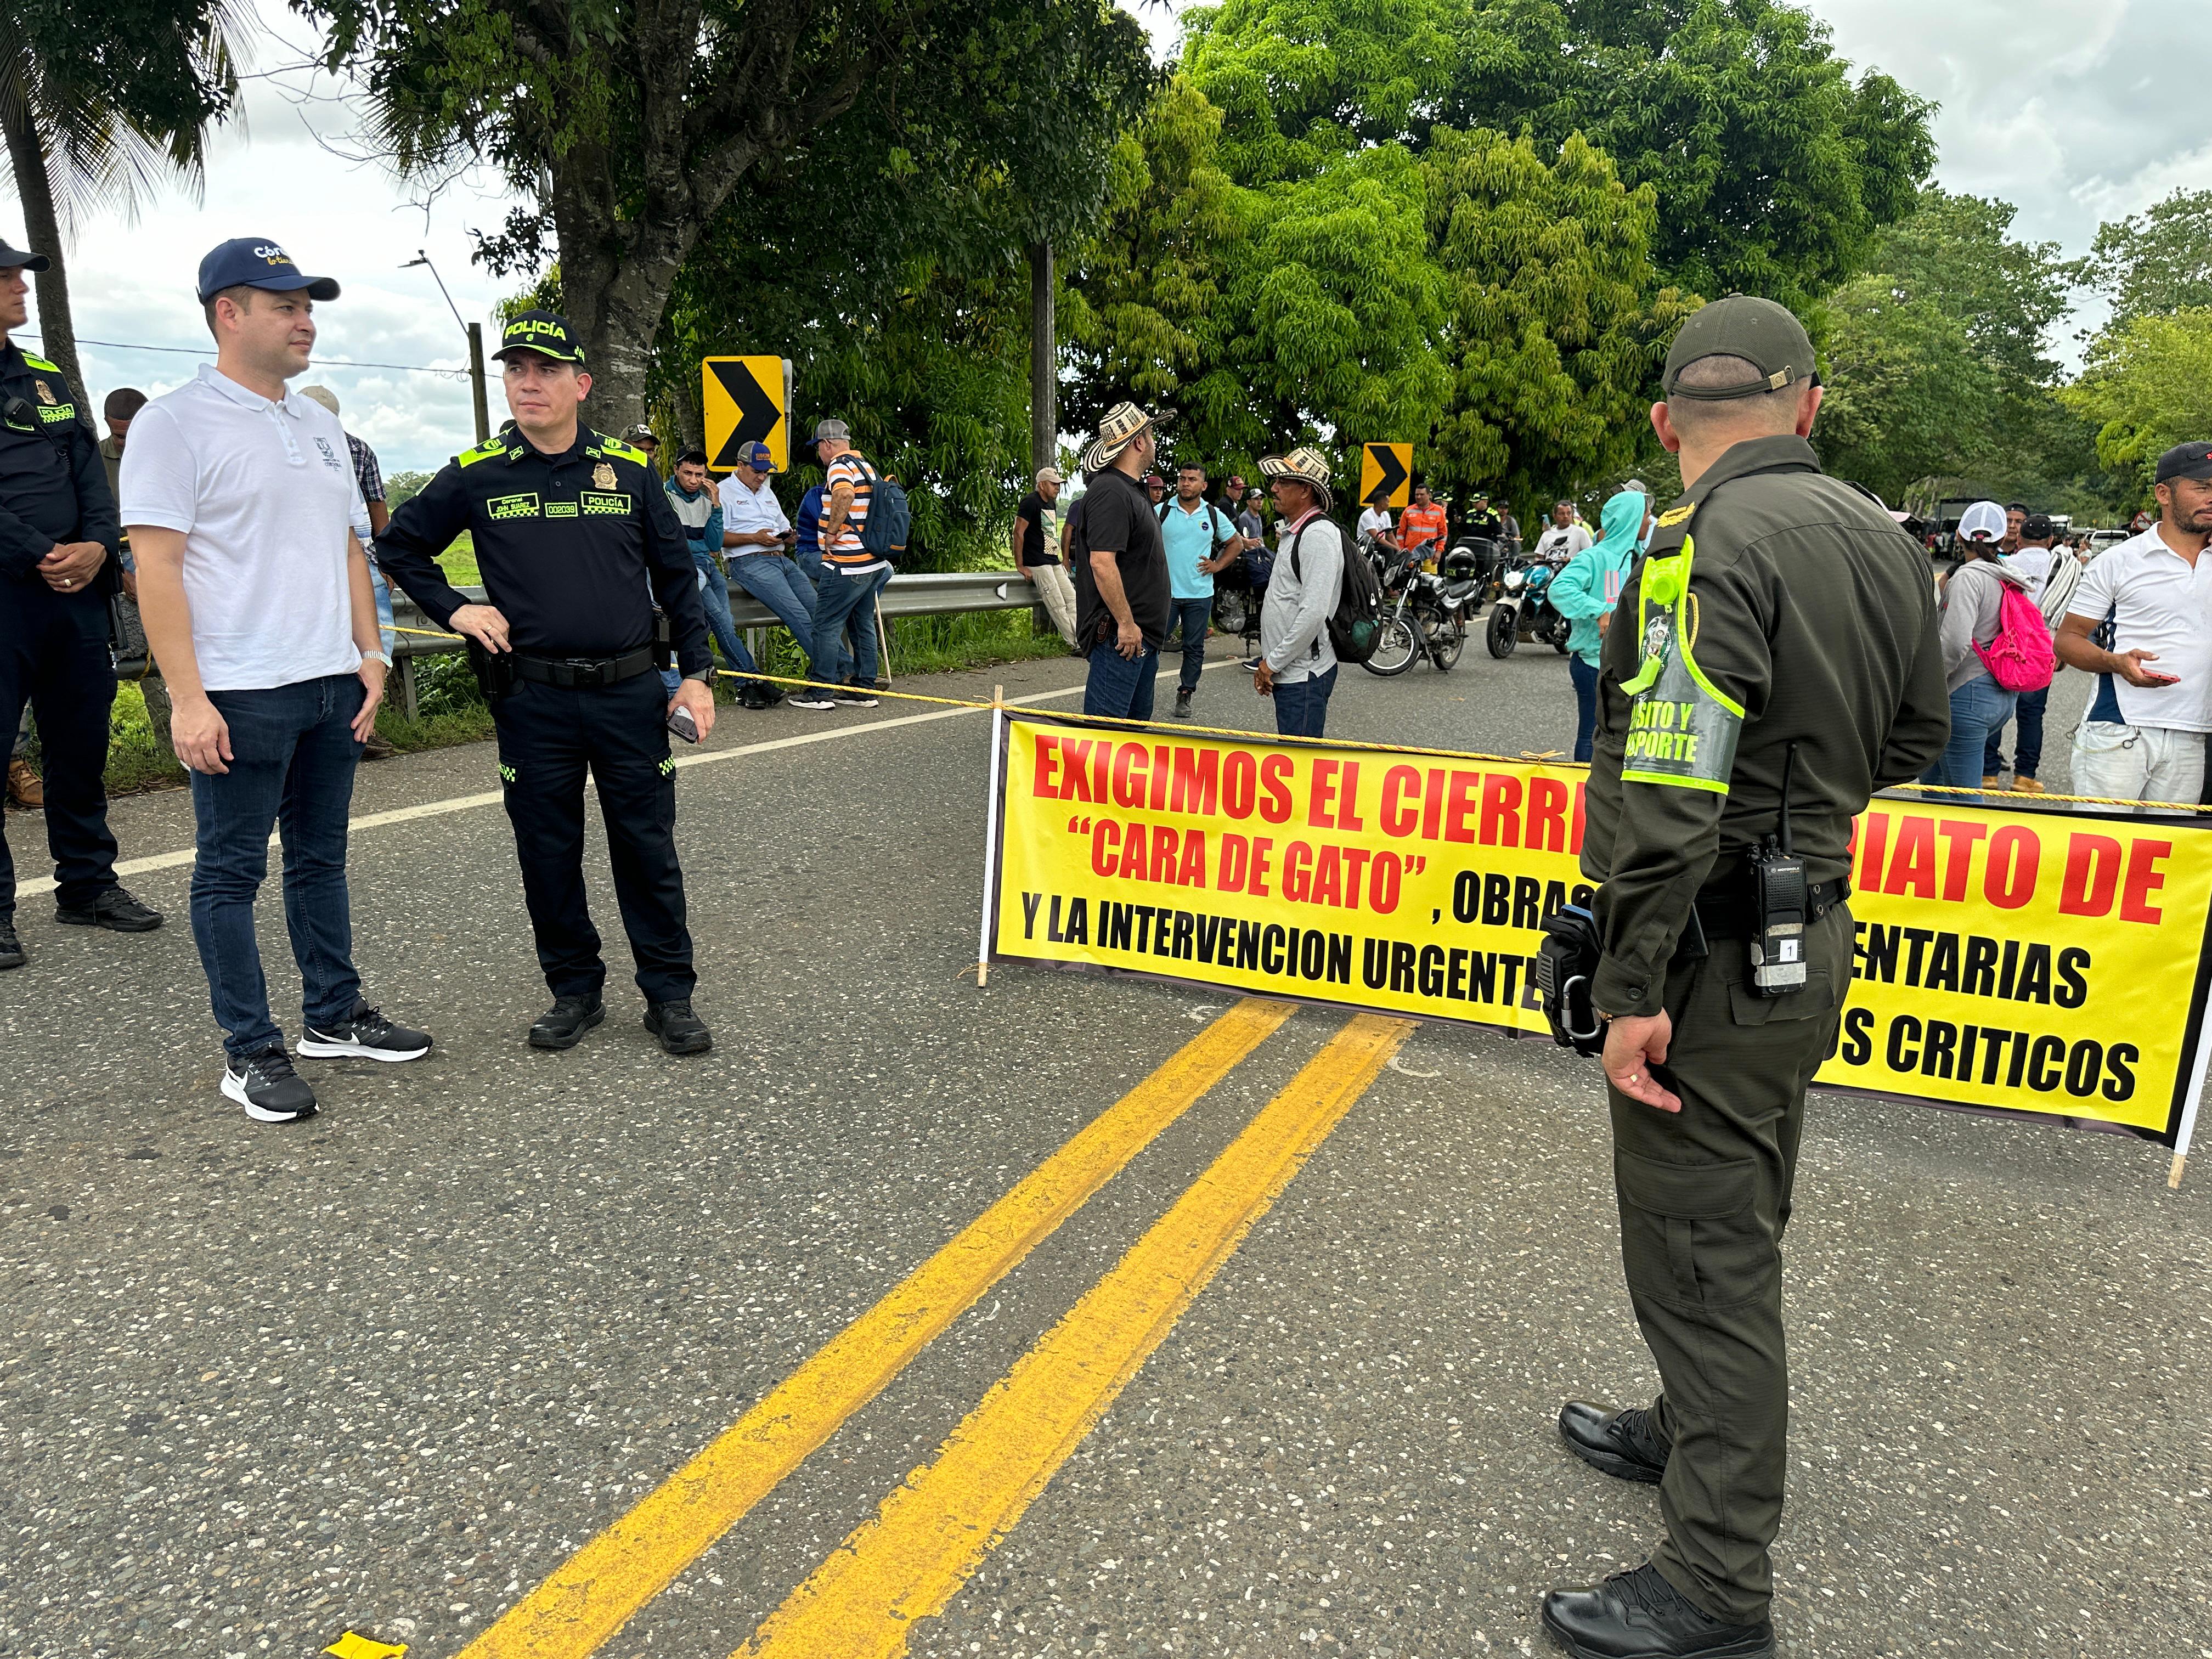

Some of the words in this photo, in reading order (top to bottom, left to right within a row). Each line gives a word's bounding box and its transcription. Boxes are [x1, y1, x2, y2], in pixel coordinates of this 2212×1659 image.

[505, 320, 567, 341] POLICÍA
[41, 407, 72, 415] POLICÍA
[511, 501, 530, 510] SUAREZ
[549, 505, 575, 514] 002039
[588, 496, 624, 508] POLICÍA
[1680, 703, 1694, 731] Y
[1034, 735, 1294, 823] EXIGIMOS
[1309, 759, 1362, 831] EL
[1847, 812, 2040, 909] IATO
[2059, 833, 2171, 924] DE
[1068, 817, 1205, 887] “CARA
[1218, 834, 1272, 896] DE
[1283, 840, 1426, 915] GATO”
[1787, 945, 1792, 957] 1
[1022, 891, 1042, 939] Y
[1047, 895, 1088, 945] LA
[1097, 900, 1352, 984] INTERVENCION
[1363, 938, 1542, 1011] URGENTE
[1886, 1015, 2139, 1102] CRITICOS
